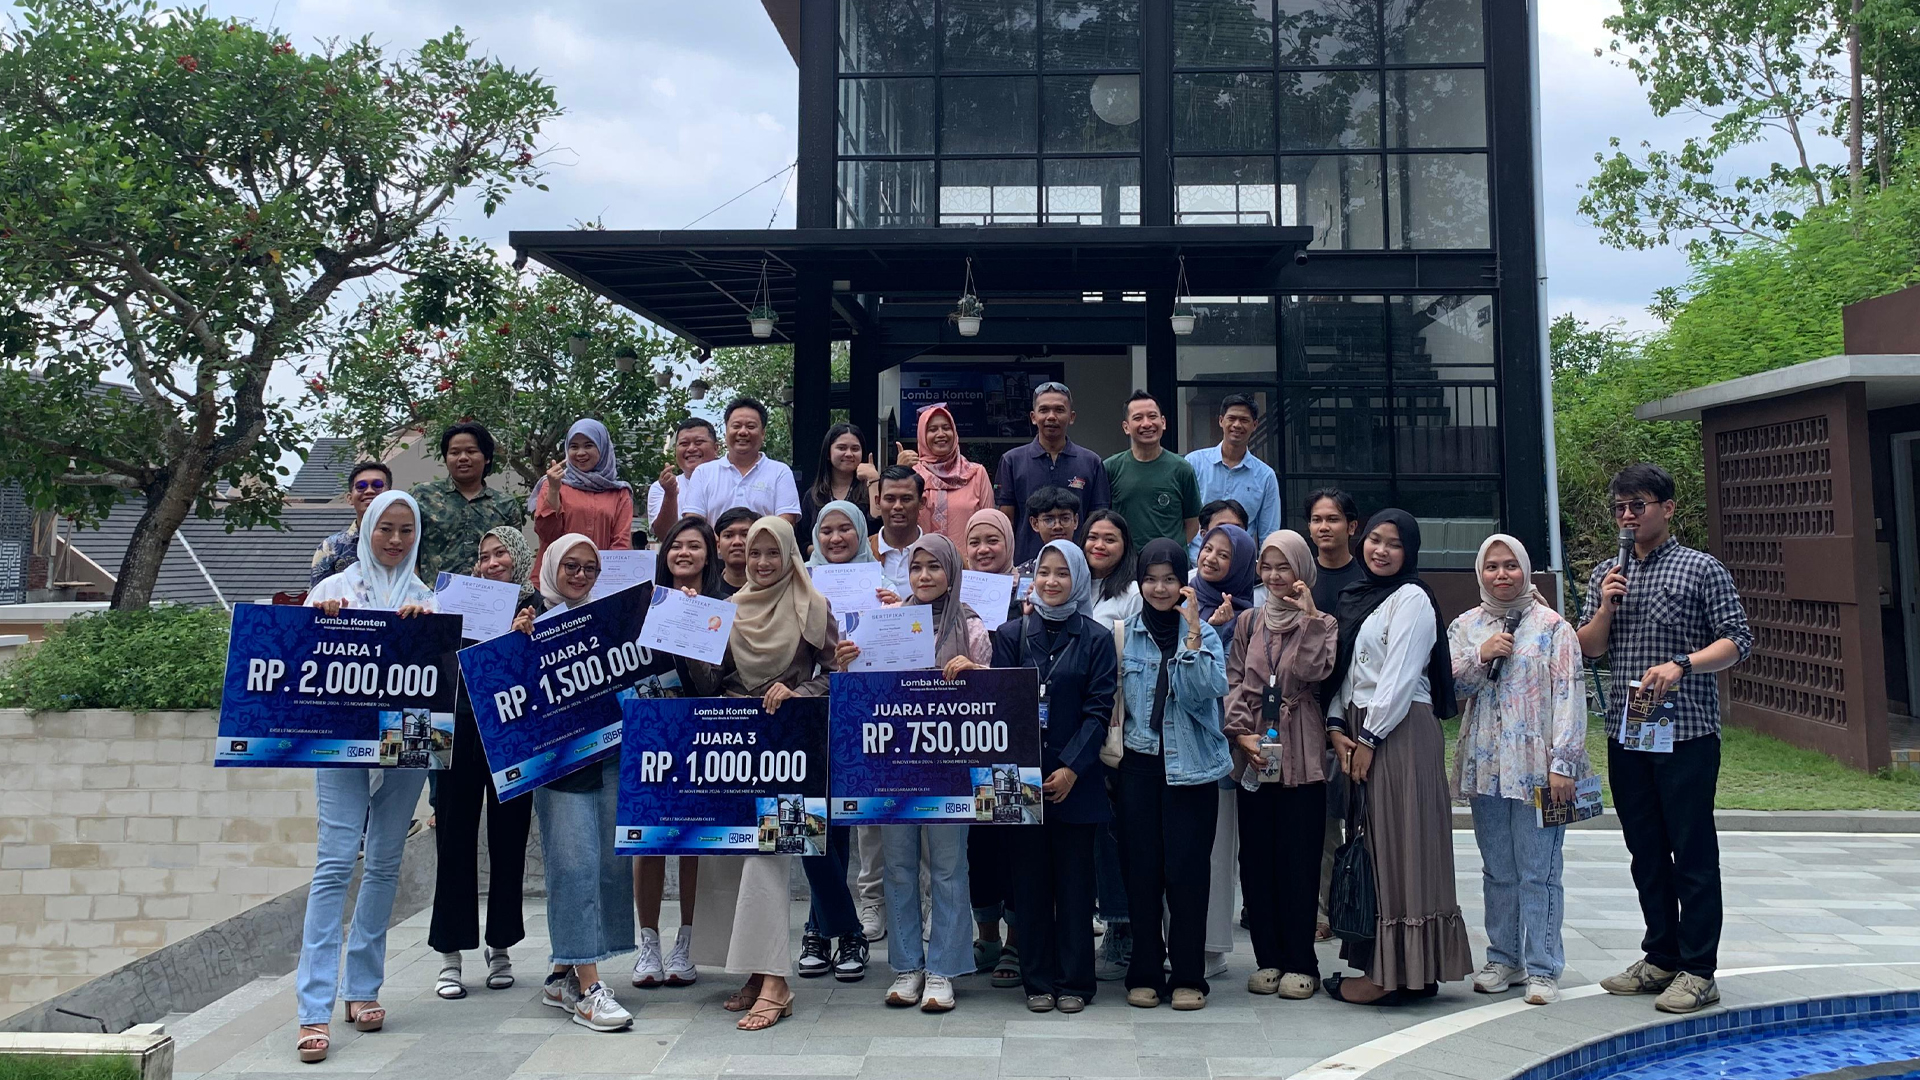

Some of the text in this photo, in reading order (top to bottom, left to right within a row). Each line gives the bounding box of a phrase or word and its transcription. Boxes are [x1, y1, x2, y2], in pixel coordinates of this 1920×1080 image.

[902, 390, 983, 399] Lomba Konten
[315, 616, 387, 627] Lomba Konten
[871, 612, 906, 620] SERTIFIKAT
[530, 626, 561, 642] Lomba
[560, 614, 593, 630] Konten
[312, 641, 382, 657] JUARA 1
[539, 641, 589, 670] JUARA
[589, 635, 600, 650] 2
[246, 658, 438, 699] RP. 2,000,000
[493, 640, 653, 724] RP. 1,500,000
[901, 678, 932, 687] Lomba
[694, 707, 759, 716] Lomba Konten
[872, 702, 997, 717] JUARA FAVORIT
[692, 731, 757, 745] JUARA 3
[862, 720, 1009, 756] RP. 750,000
[357, 747, 375, 757] BRI
[640, 750, 807, 786] RP. 1,000,000
[955, 803, 971, 813] BRI
[739, 833, 754, 843] BRI
